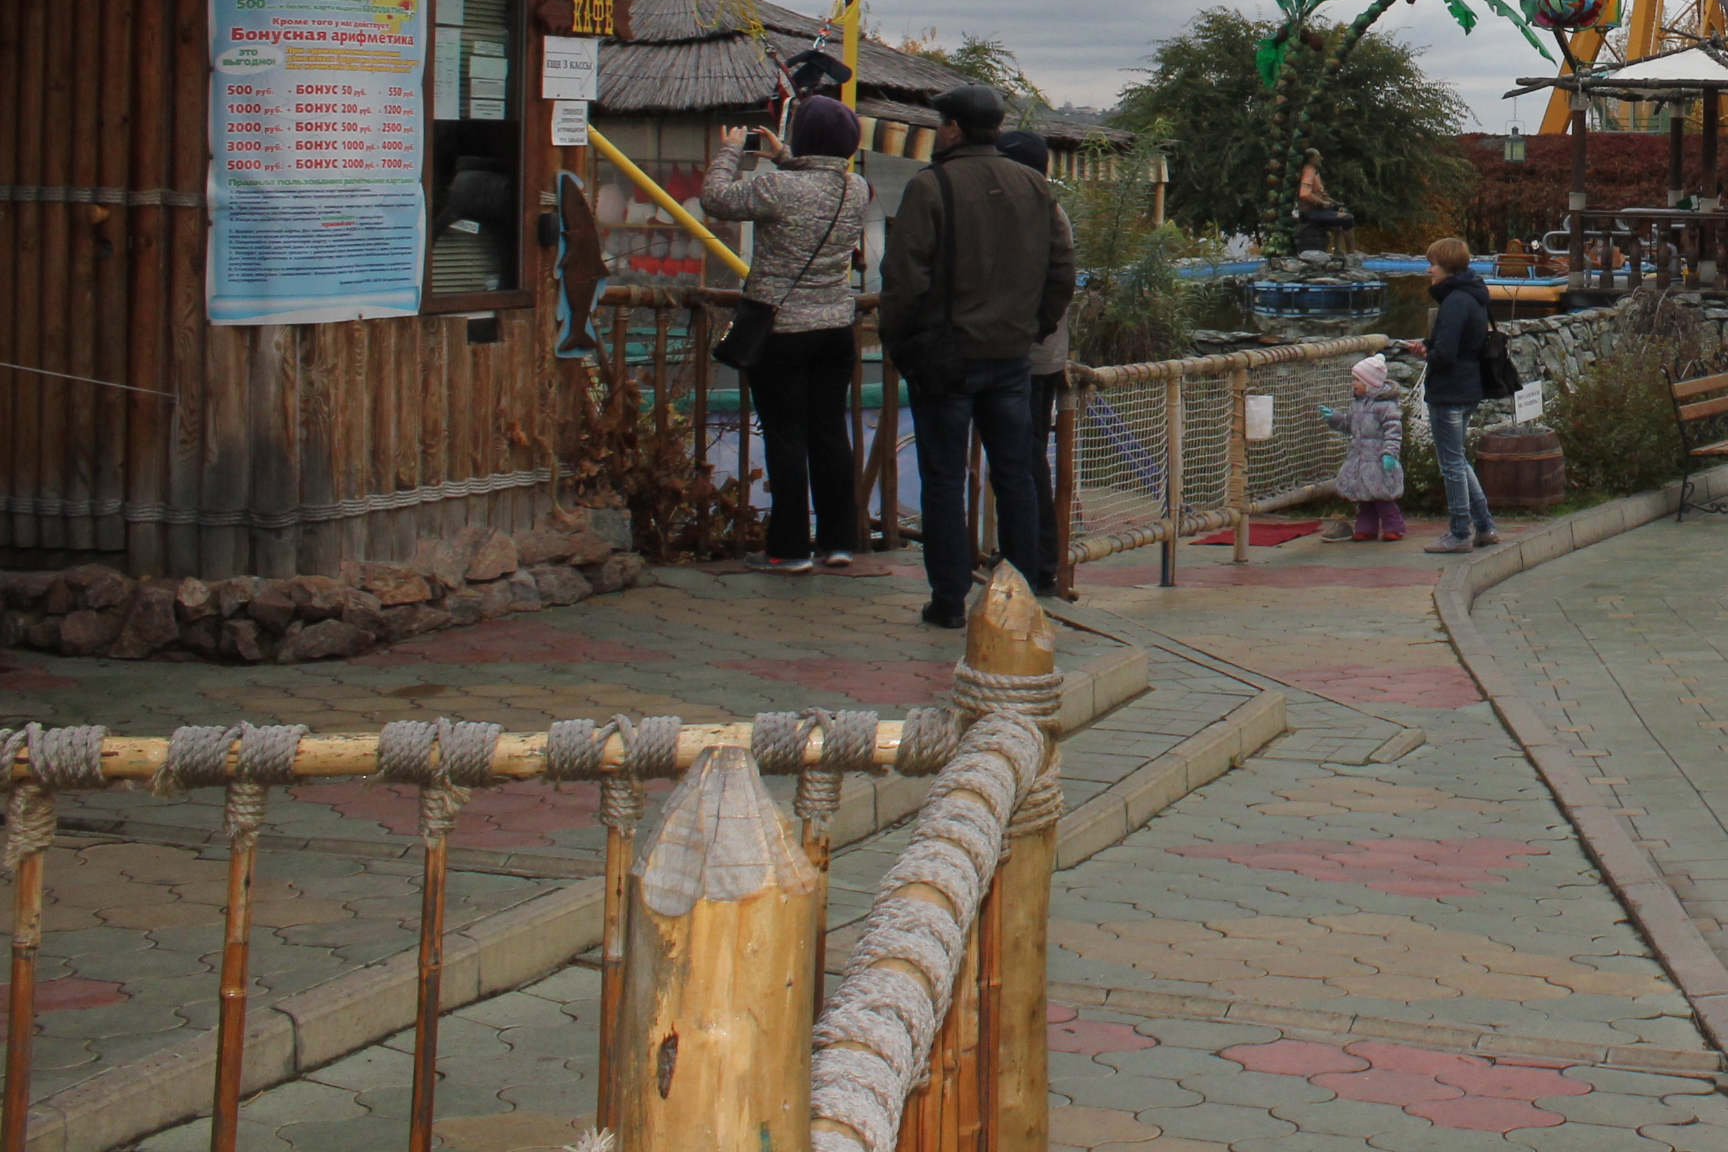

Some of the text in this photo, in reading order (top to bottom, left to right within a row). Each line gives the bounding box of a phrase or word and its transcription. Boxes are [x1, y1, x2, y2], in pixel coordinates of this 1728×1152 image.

[272, 18, 309, 27] Кроме
[231, 28, 414, 46] Бонусная арифметика
[222, 58, 276, 66] ВЫГОДНО!
[546, 59, 592, 70] ЕЩЕ 3 КАССЫ
[227, 85, 253, 95] 500
[255, 87, 274, 97] руб.
[296, 84, 338, 95] БОНУС
[342, 85, 353, 95] 50
[354, 89, 367, 97] руб.
[388, 87, 402, 97] 550
[403, 90, 414, 98] руб.
[227, 104, 261, 114] 1000
[264, 106, 283, 115] руб.
[295, 103, 338, 113] БОНУС
[341, 103, 358, 113] 200
[359, 107, 372, 115] руб.
[384, 105, 402, 114] 1200
[403, 108, 414, 116] руб.
[227, 122, 261, 132] 2000
[264, 125, 283, 134] руб.
[295, 122, 338, 132] БОНУС
[341, 122, 358, 132] 500
[360, 125, 372, 133] руб.
[382, 123, 402, 132] 2500
[403, 126, 414, 134] руб.
[227, 141, 261, 151] 3000
[264, 144, 283, 152] руб.
[295, 140, 338, 150] БОНУС
[342, 141, 364, 150] 1000
[366, 143, 375, 152] руб.
[381, 141, 403, 150] 4000
[404, 144, 414, 152] руб.
[227, 160, 261, 170] 5000
[264, 162, 283, 171] руб.
[296, 159, 338, 169] БОНУС
[342, 159, 364, 169] 2000
[364, 162, 375, 170] руб.
[381, 159, 402, 168] 7000
[403, 162, 414, 170] руб.
[228, 179, 275, 187] Правила
